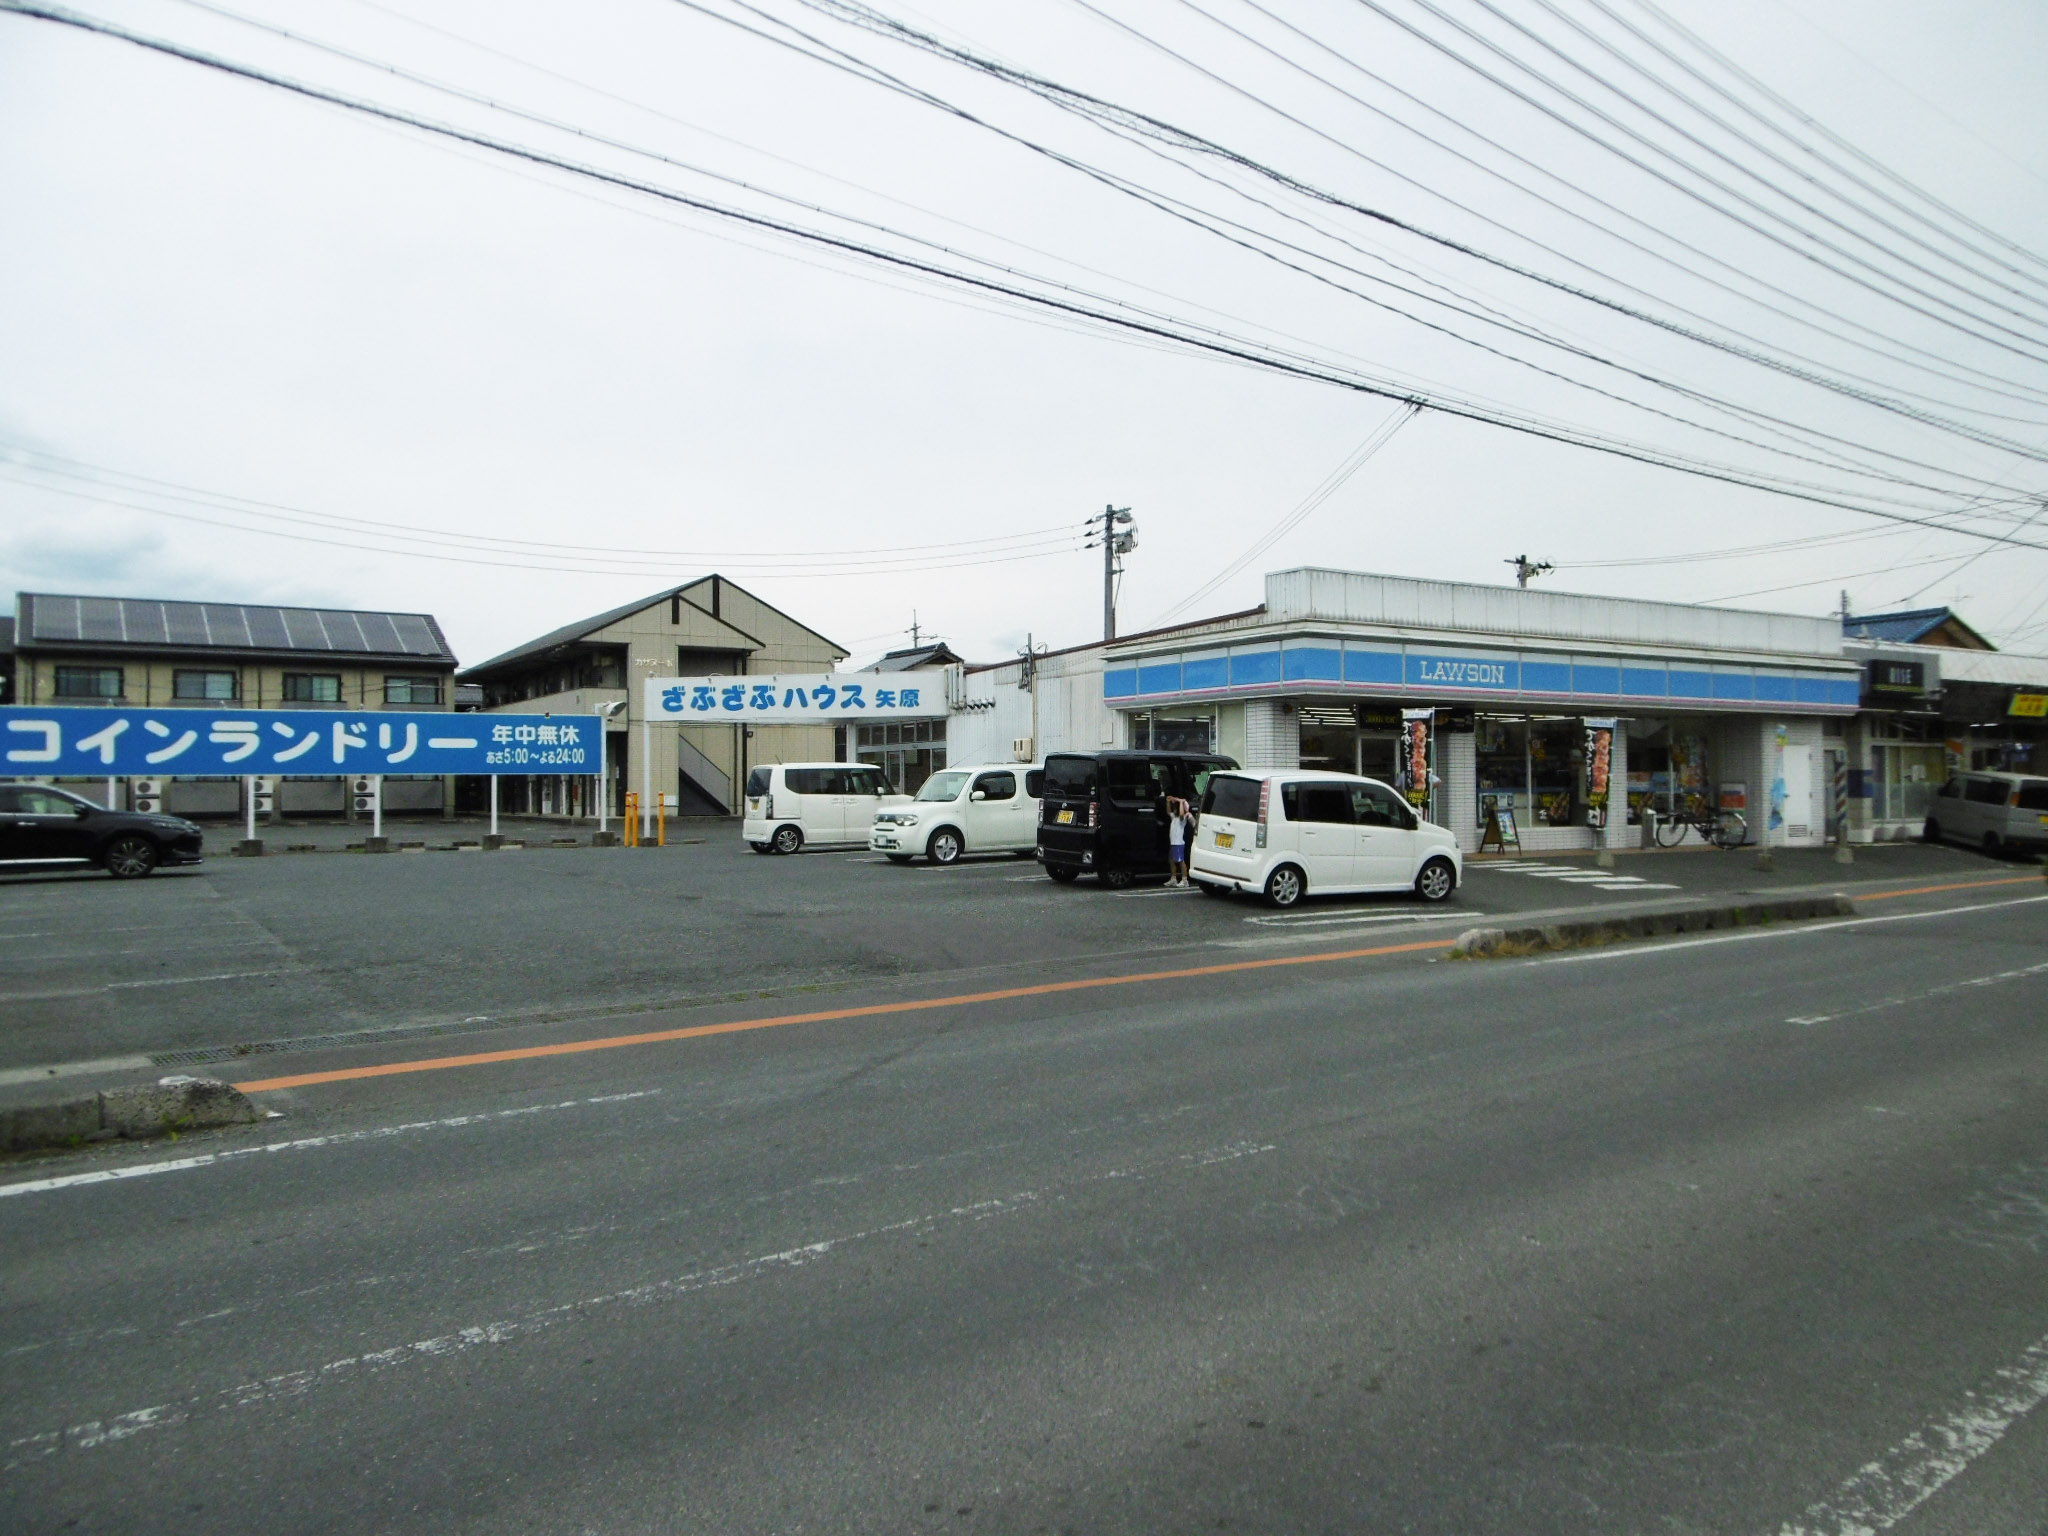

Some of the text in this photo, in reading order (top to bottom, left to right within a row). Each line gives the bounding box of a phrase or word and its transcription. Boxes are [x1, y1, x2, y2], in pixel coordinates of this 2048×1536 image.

[1420, 660, 1505, 683] LAWSON
[662, 684, 920, 713] ざぶざぶハウス 矢原
[7, 717, 478, 765] コインランドリー
[492, 724, 580, 745] 年中無休
